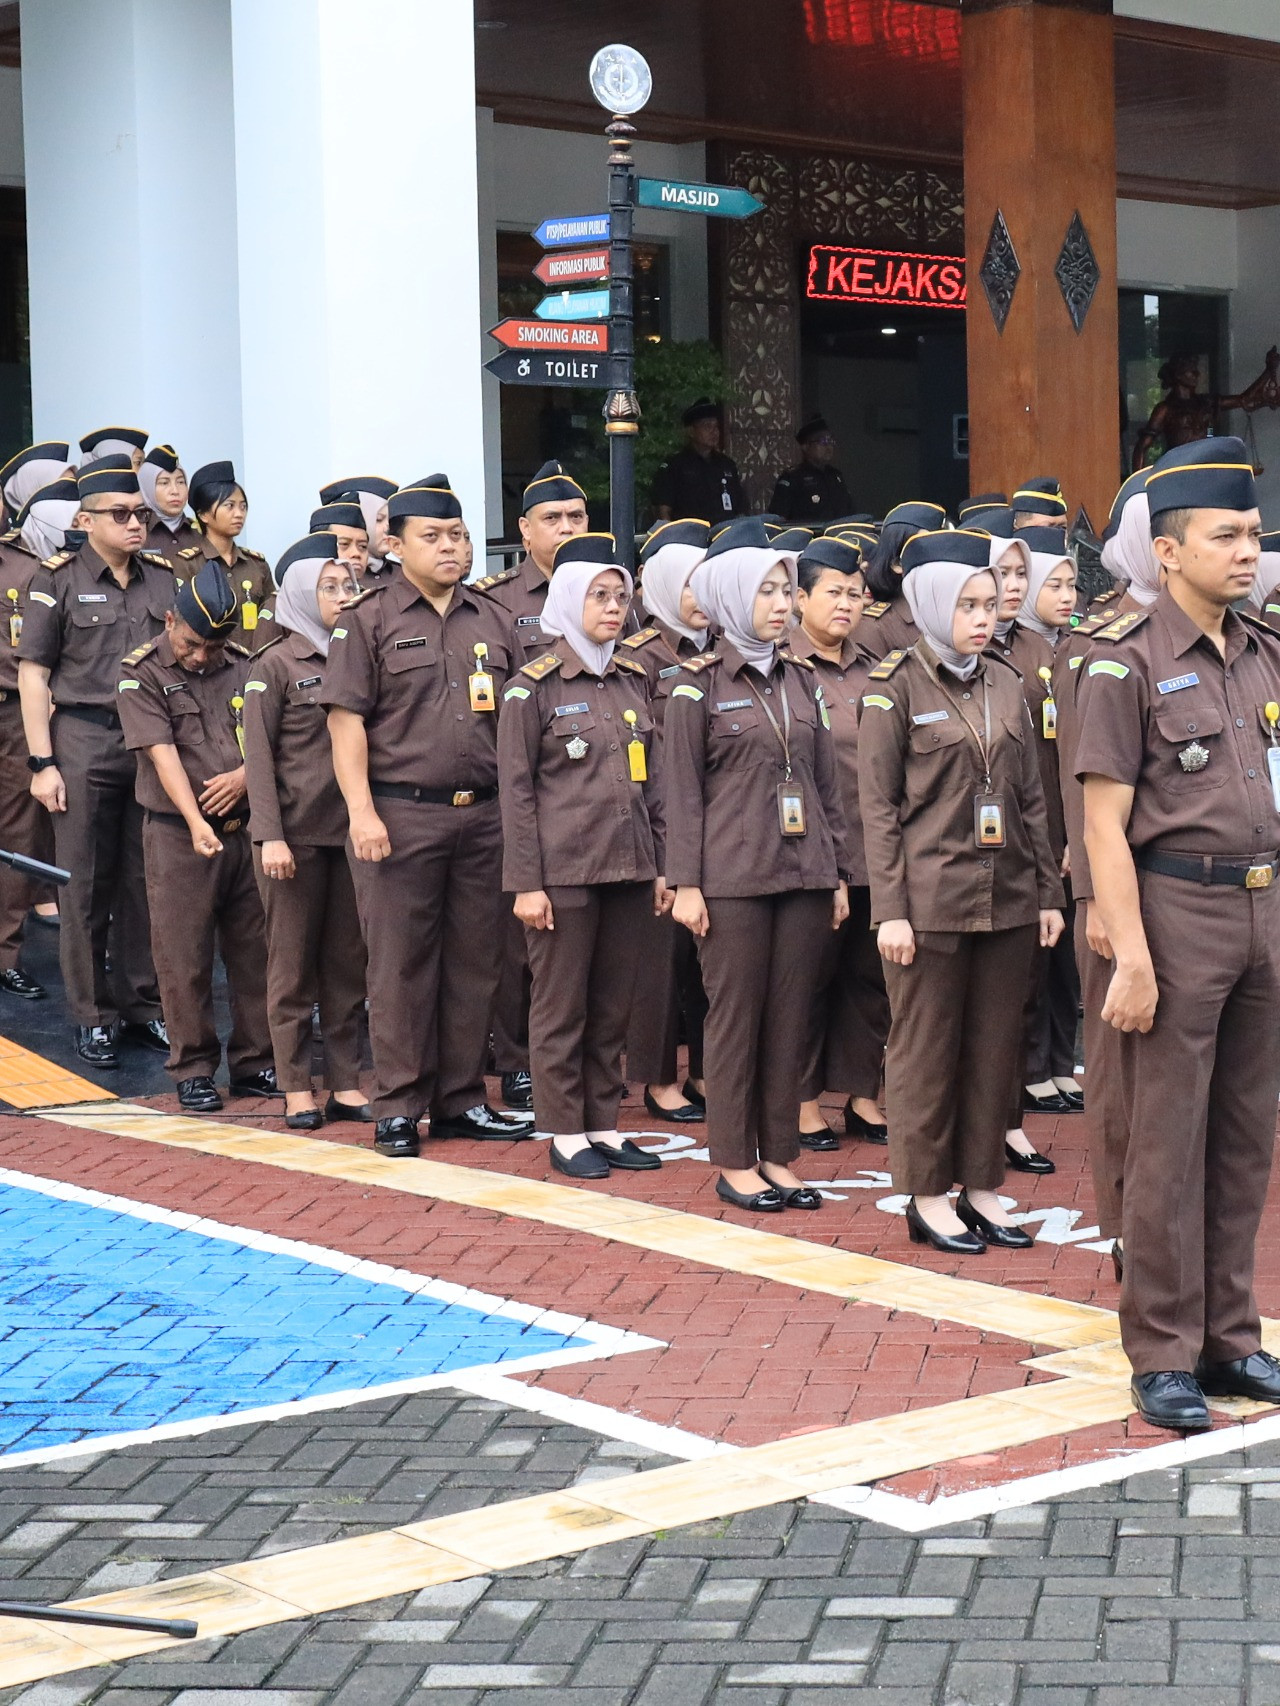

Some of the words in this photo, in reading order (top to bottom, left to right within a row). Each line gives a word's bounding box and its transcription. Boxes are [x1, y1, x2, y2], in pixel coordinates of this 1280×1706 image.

[661, 186, 719, 207] MASJID
[588, 220, 607, 235] PUBLIK
[549, 258, 583, 276] INFORMASI
[584, 256, 605, 272] PUBLIK
[827, 255, 967, 301] KEJAKS
[518, 327, 569, 343] SMOKING
[571, 329, 599, 345] AREA
[545, 361, 599, 378] TOILET
[1167, 678, 1190, 689] SATYA
